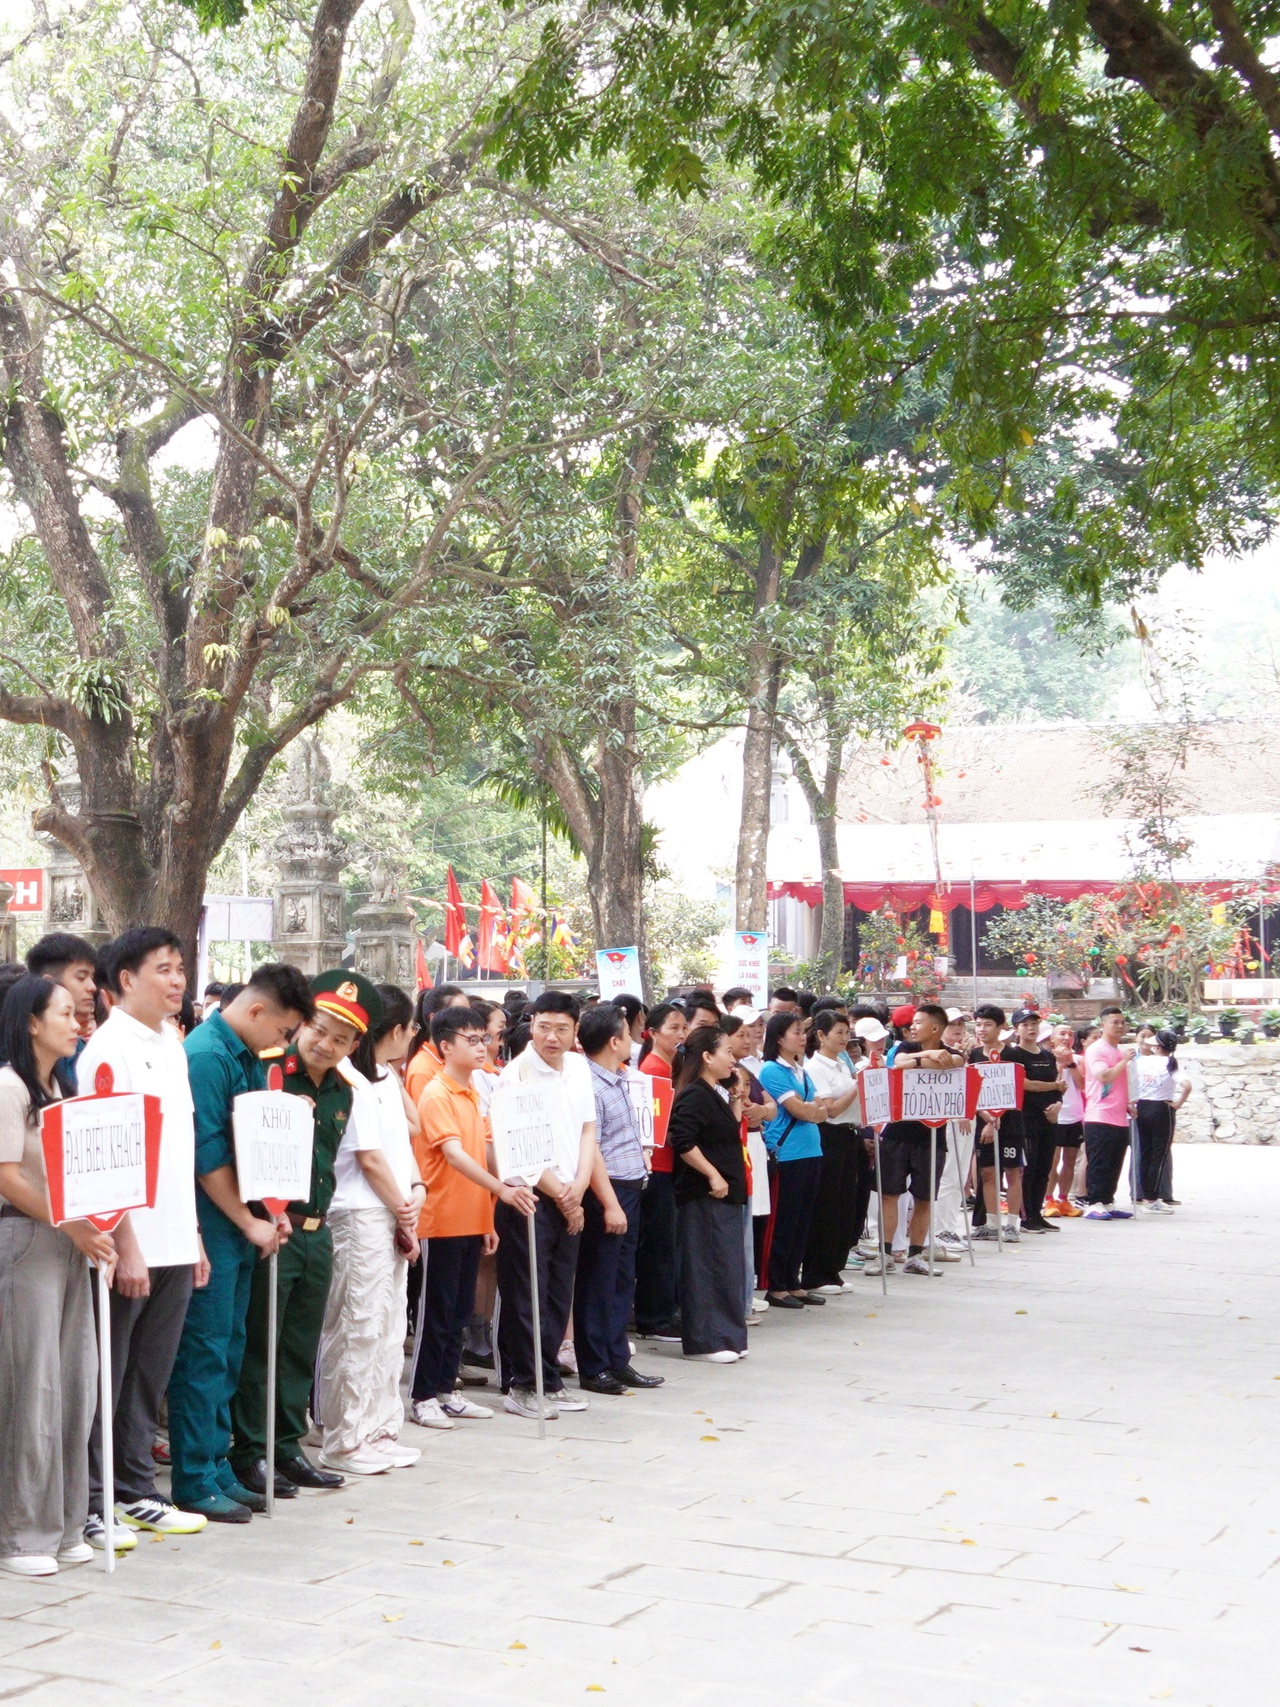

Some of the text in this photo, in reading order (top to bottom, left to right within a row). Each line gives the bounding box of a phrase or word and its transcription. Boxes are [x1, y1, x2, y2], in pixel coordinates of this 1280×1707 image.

[917, 1069, 953, 1085] KHỐI
[904, 1085, 917, 1116] TỔ
[920, 1086, 942, 1116] DÂN
[1003, 1146, 1017, 1159] 99
